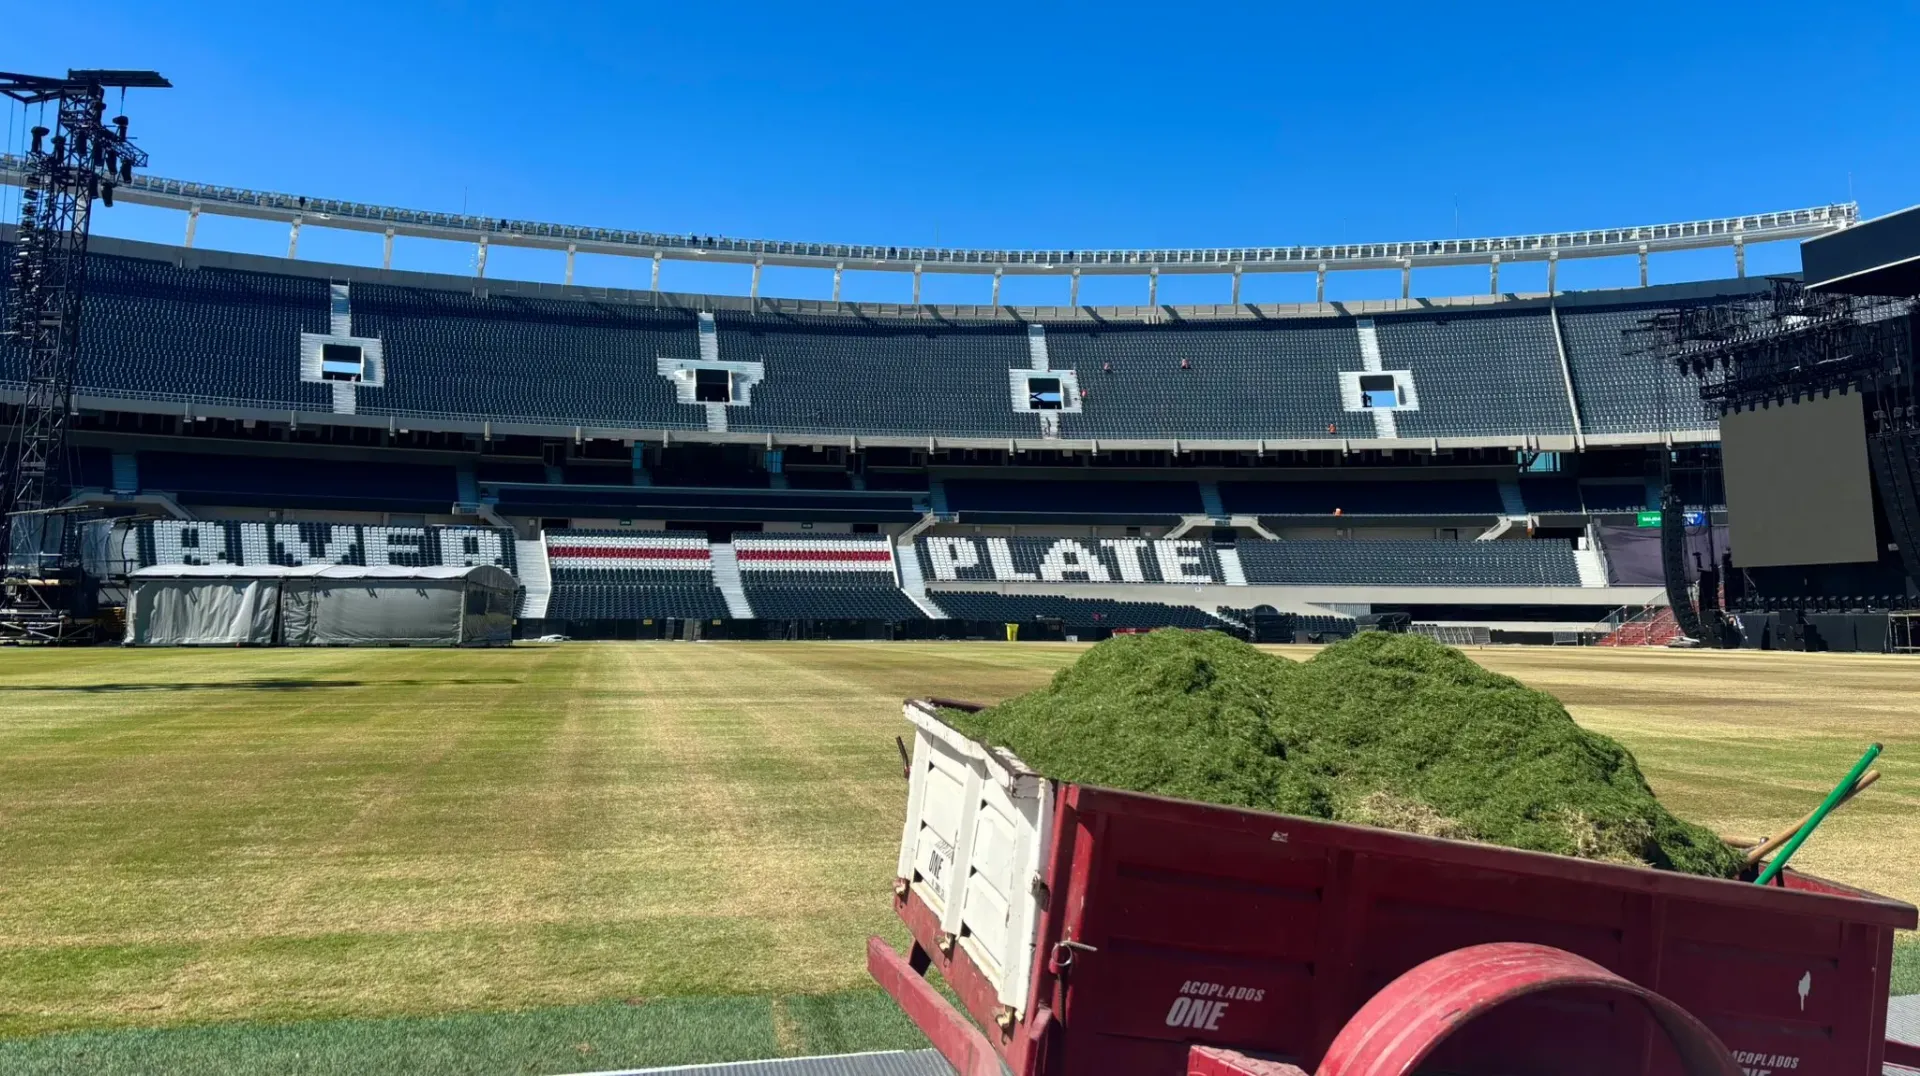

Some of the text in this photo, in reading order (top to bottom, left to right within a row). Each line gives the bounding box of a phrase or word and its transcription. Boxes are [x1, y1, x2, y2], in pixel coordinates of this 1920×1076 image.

[926, 536, 1212, 583] PLATE
[929, 850, 944, 880] ONE
[1179, 980, 1265, 1002] ACOPLADOS
[1165, 997, 1229, 1030] ONE
